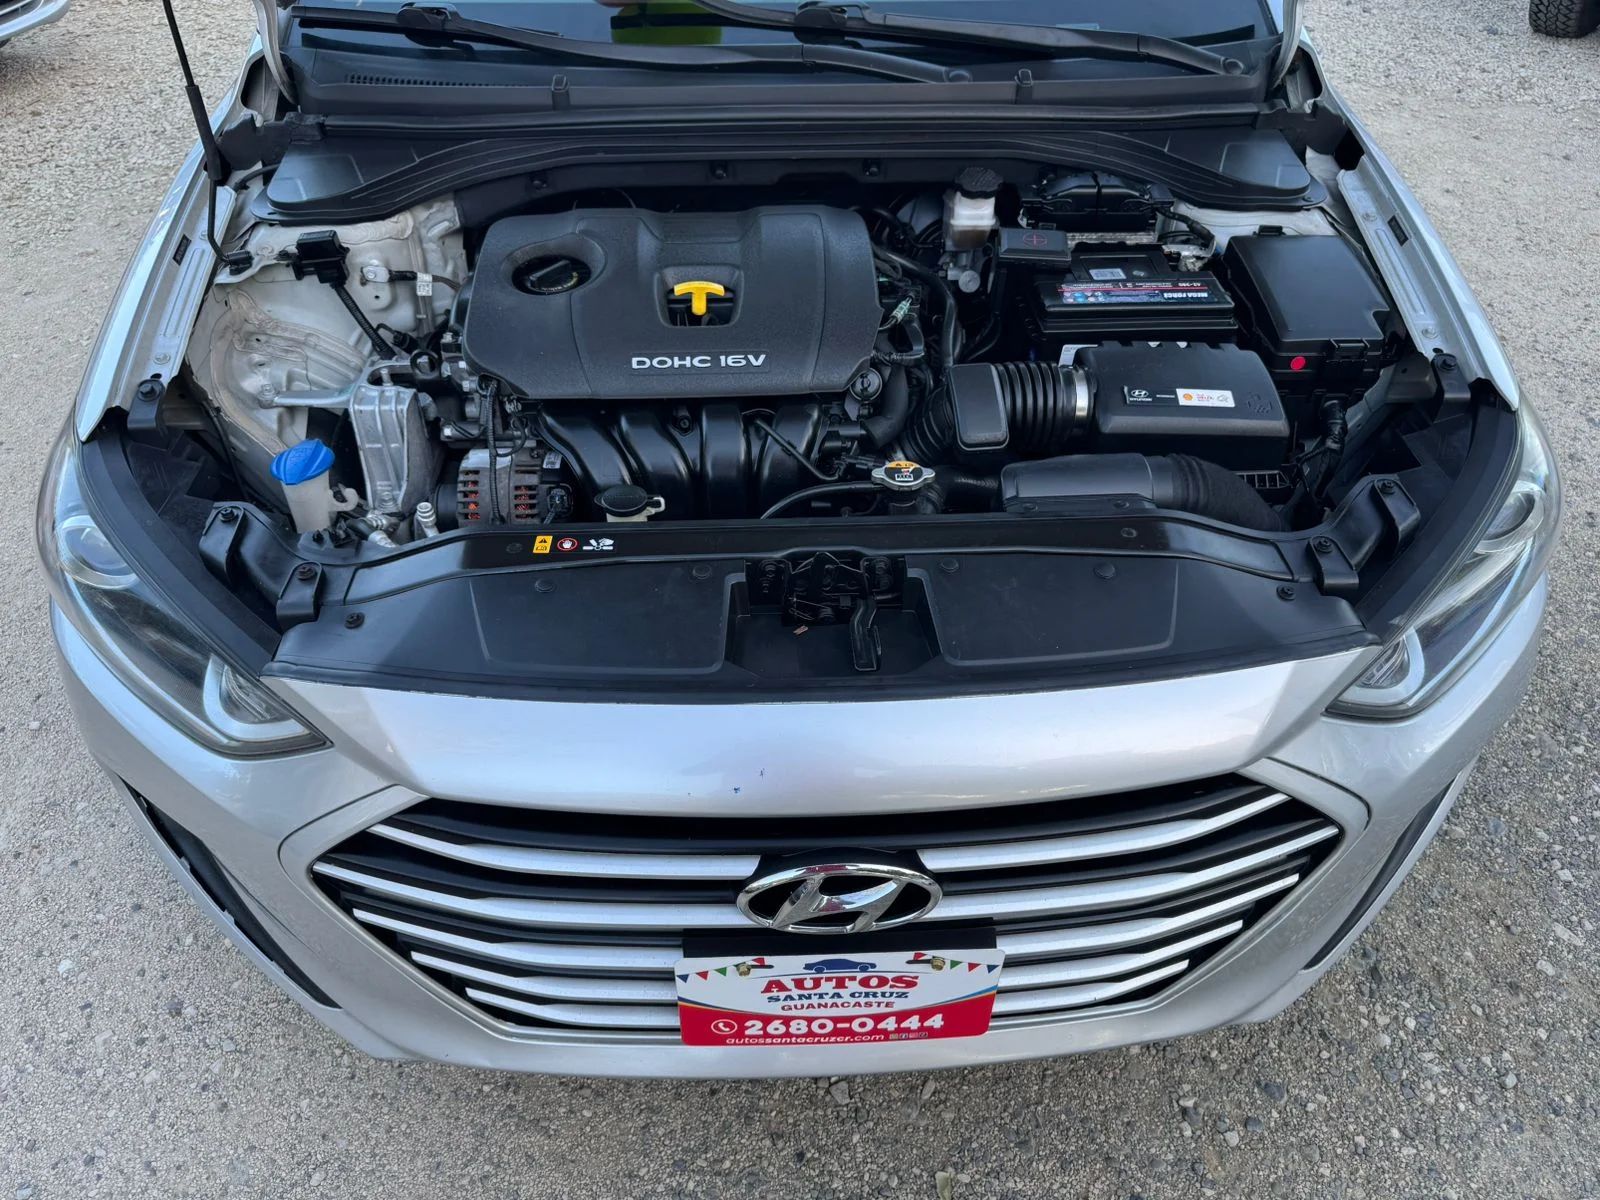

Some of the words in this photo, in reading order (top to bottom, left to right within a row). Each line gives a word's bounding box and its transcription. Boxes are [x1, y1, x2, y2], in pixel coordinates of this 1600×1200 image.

[631, 356, 712, 370] DOHC
[719, 354, 767, 367] 16V
[760, 975, 919, 994] AUTOS
[767, 990, 843, 1003] SANTA
[849, 990, 910, 1000] CRUZ
[781, 1001, 895, 1012] GUANACASTE
[744, 1013, 944, 1035] 2680-0444
[726, 1034, 885, 1045] autossantacruzcr.com
